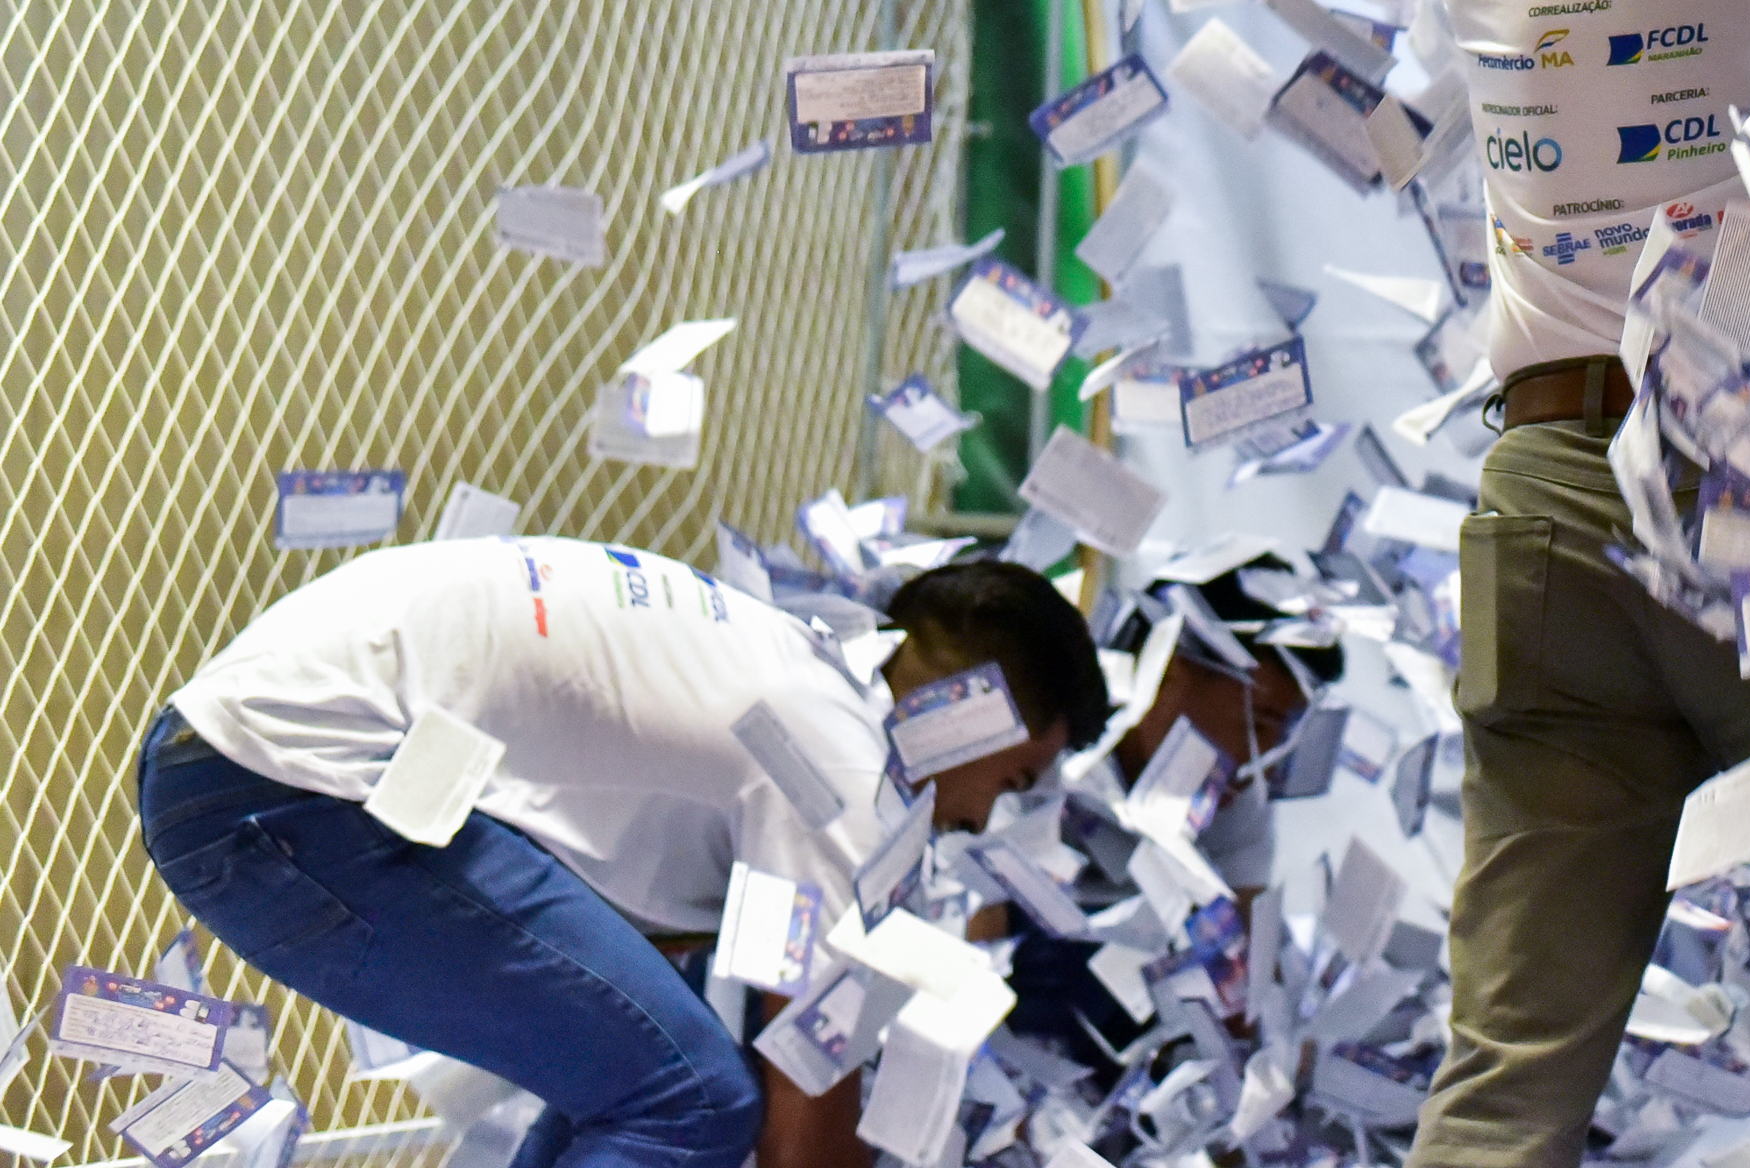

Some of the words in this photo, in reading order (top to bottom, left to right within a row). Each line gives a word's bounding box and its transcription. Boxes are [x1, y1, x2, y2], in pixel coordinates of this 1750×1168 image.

[1647, 22, 1709, 50] FCDL
[1541, 51, 1575, 69] MA
[1651, 87, 1709, 105] PARCERIA:
[1664, 114, 1720, 144] CDL
[1486, 128, 1563, 172] cielo
[1667, 141, 1726, 162] Pinheiro
[1594, 223, 1633, 238] novo
[1543, 237, 1591, 257] SEBRAE
